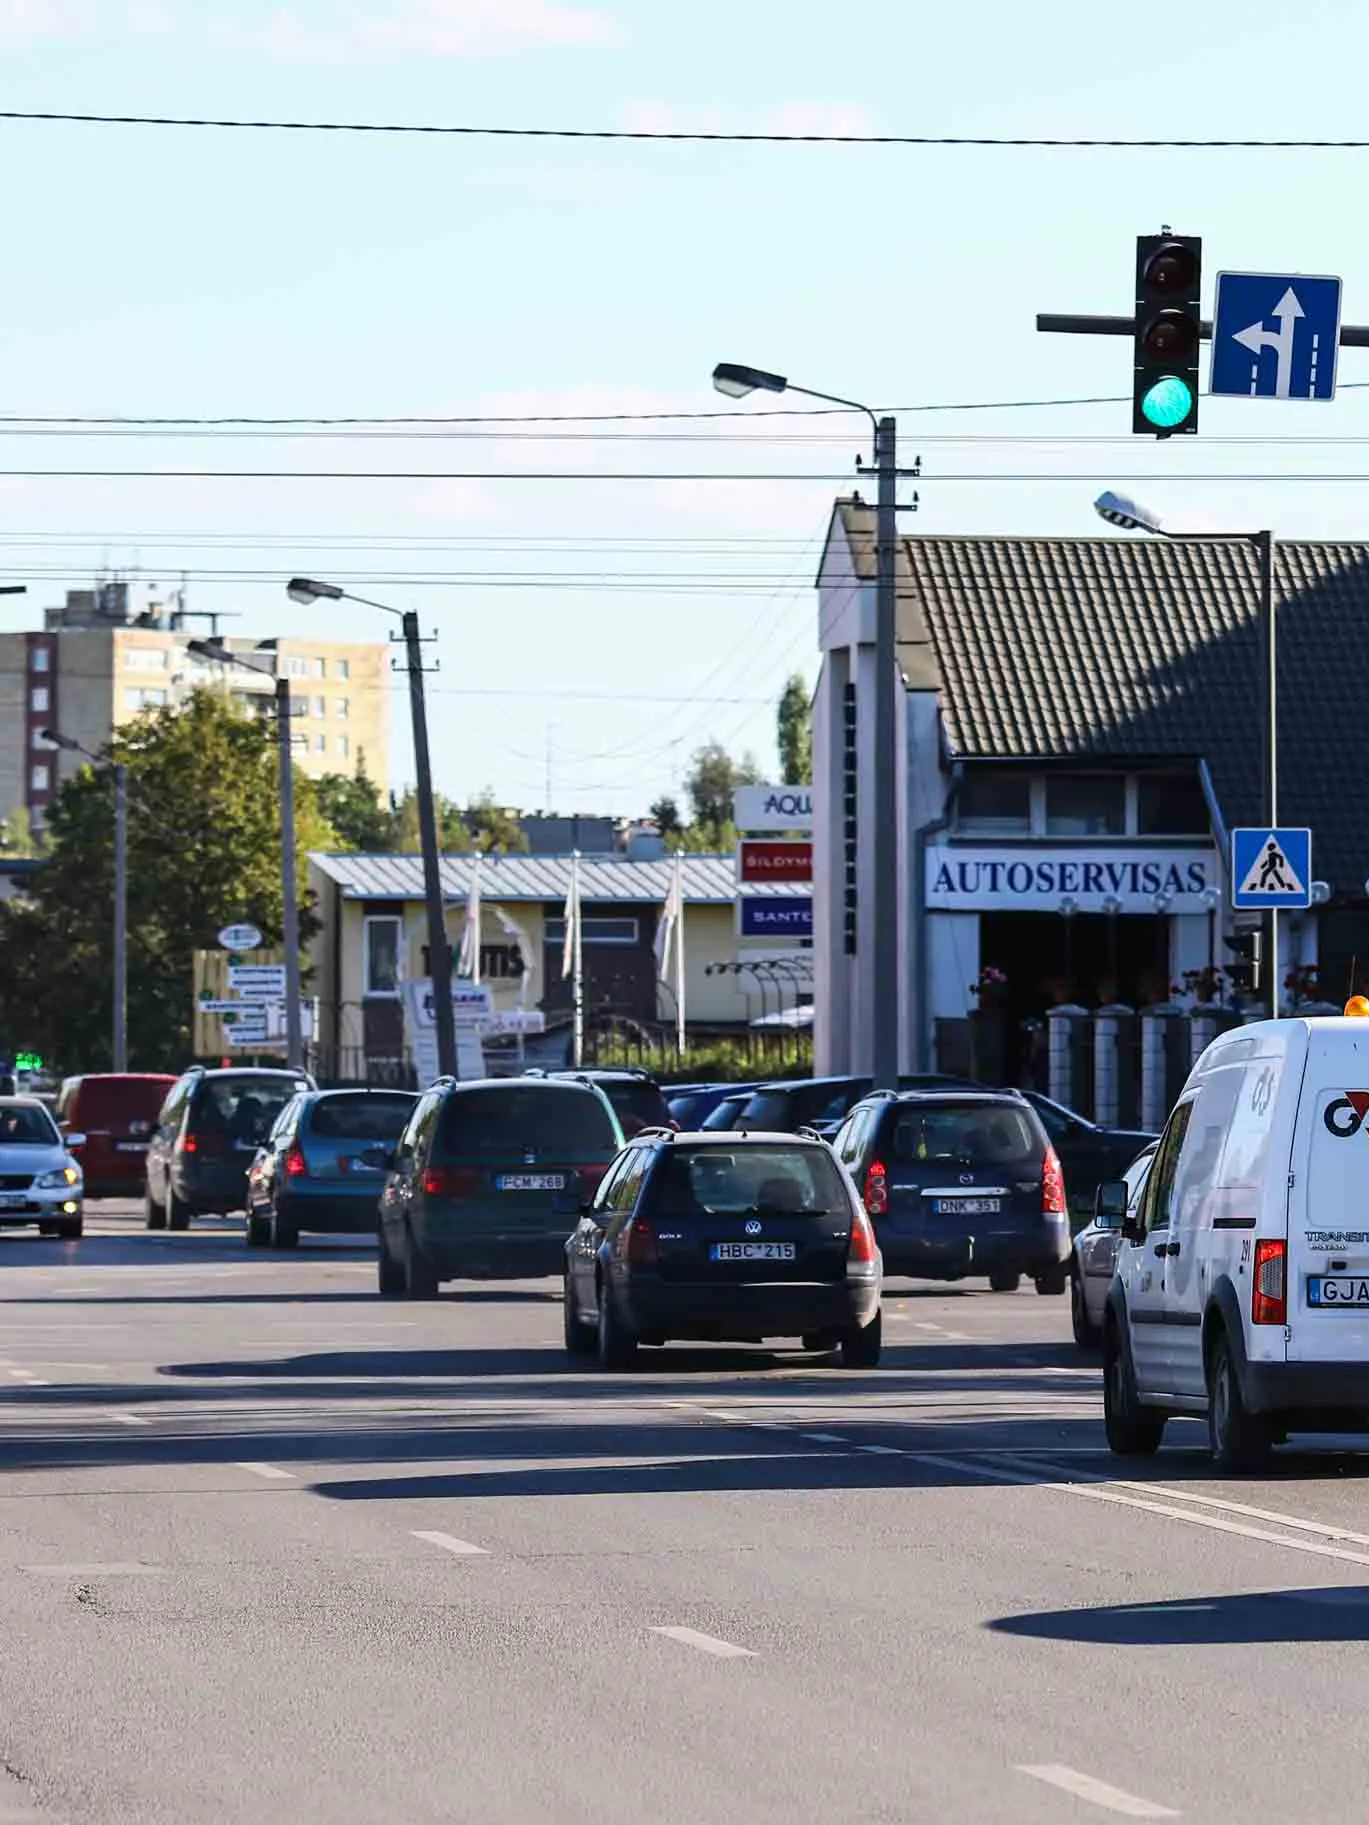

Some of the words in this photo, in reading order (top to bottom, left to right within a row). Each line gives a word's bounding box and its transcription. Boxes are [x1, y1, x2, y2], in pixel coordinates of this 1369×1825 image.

[932, 862, 1206, 894] AUTOSERVISAS
[719, 1244, 754, 1259] HBC
[764, 1244, 793, 1259] 215
[1323, 1281, 1369, 1301] GJA
